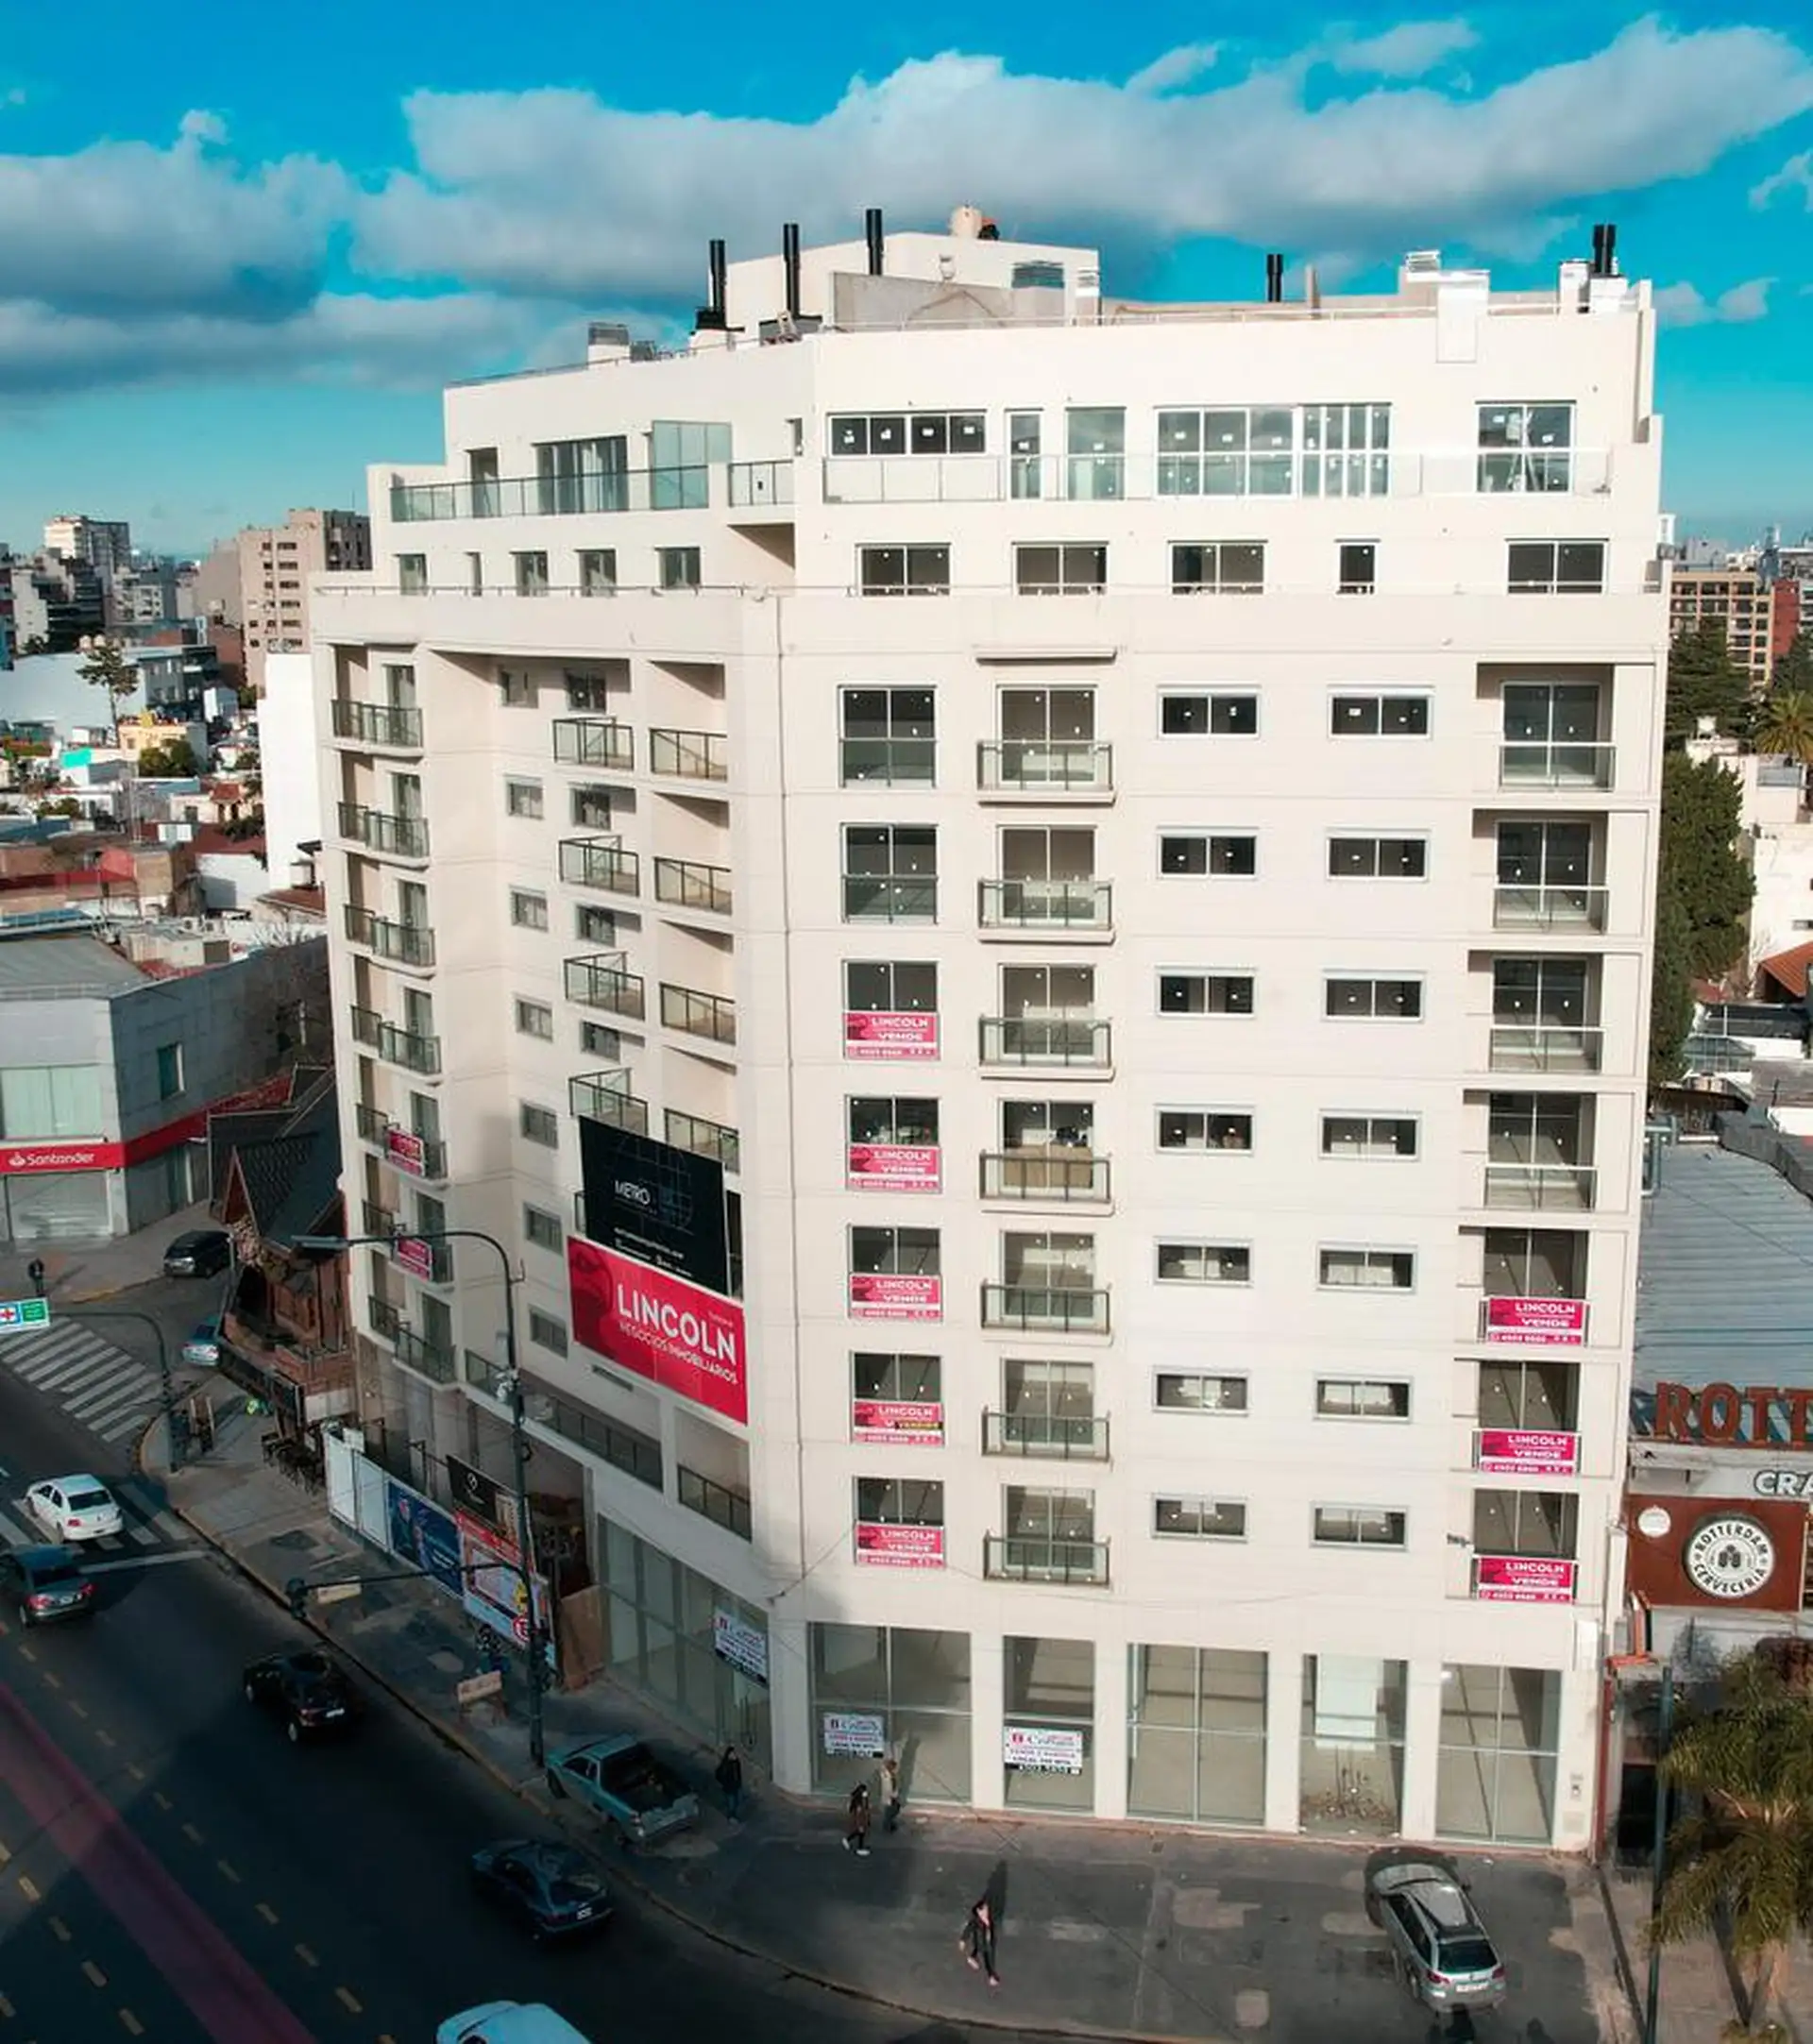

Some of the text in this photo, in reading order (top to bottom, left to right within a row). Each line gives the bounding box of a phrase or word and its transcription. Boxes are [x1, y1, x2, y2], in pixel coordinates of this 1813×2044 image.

[872, 1017, 928, 1029] LINCOLN
[26, 1152, 94, 1166] Santander
[873, 1150, 931, 1161] LINCOLN
[614, 1180, 651, 1206] METRO
[875, 1280, 932, 1291] LINCOLN
[1515, 1302, 1575, 1314] LINCOLN
[618, 1283, 737, 1366] LINCOLN
[1521, 1318, 1569, 1327] VENDE
[618, 1321, 668, 1352] NEGOCIOS
[878, 1406, 933, 1417] LINCOLN
[1507, 1434, 1567, 1445] LINCOLN
[880, 1529, 936, 1540] LINCOLN
[1694, 1523, 1769, 1555] ROTTERDAM
[1505, 1562, 1565, 1573] LINCOLN
